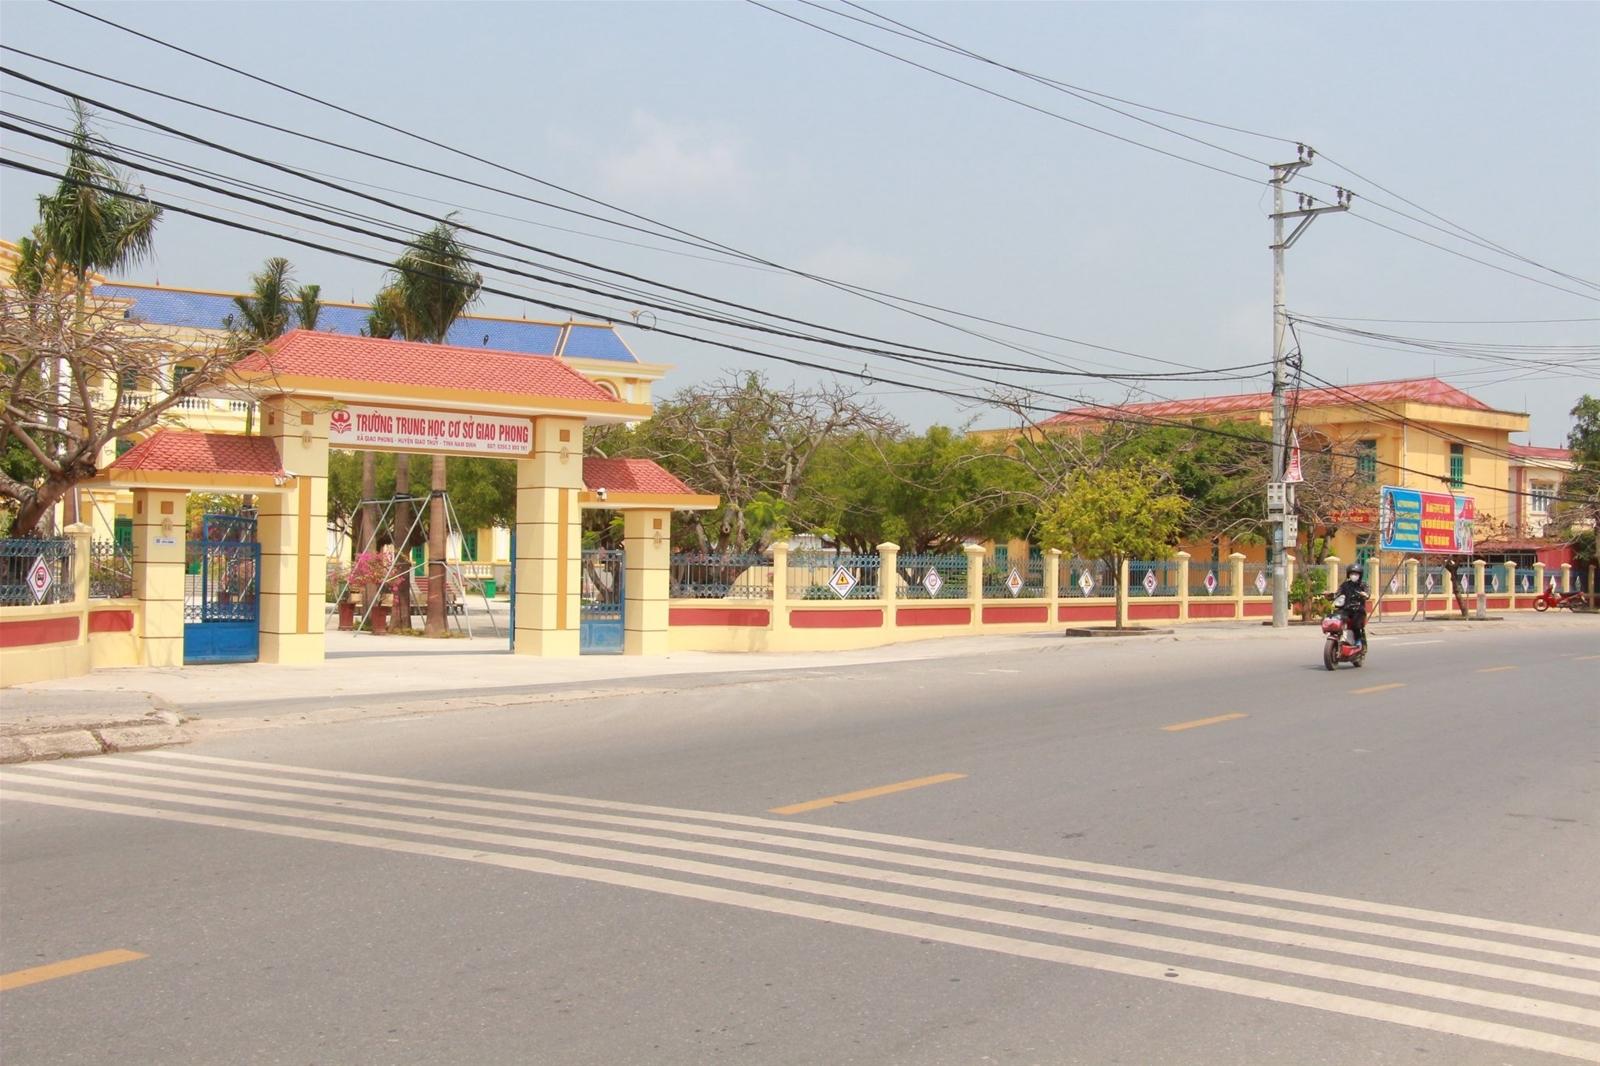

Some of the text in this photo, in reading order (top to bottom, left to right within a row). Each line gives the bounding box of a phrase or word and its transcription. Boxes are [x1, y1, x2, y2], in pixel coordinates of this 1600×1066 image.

[356, 410, 529, 443] TRƯỜNG TRUNG HỌC CƠ SỞ GIAO PHONG
